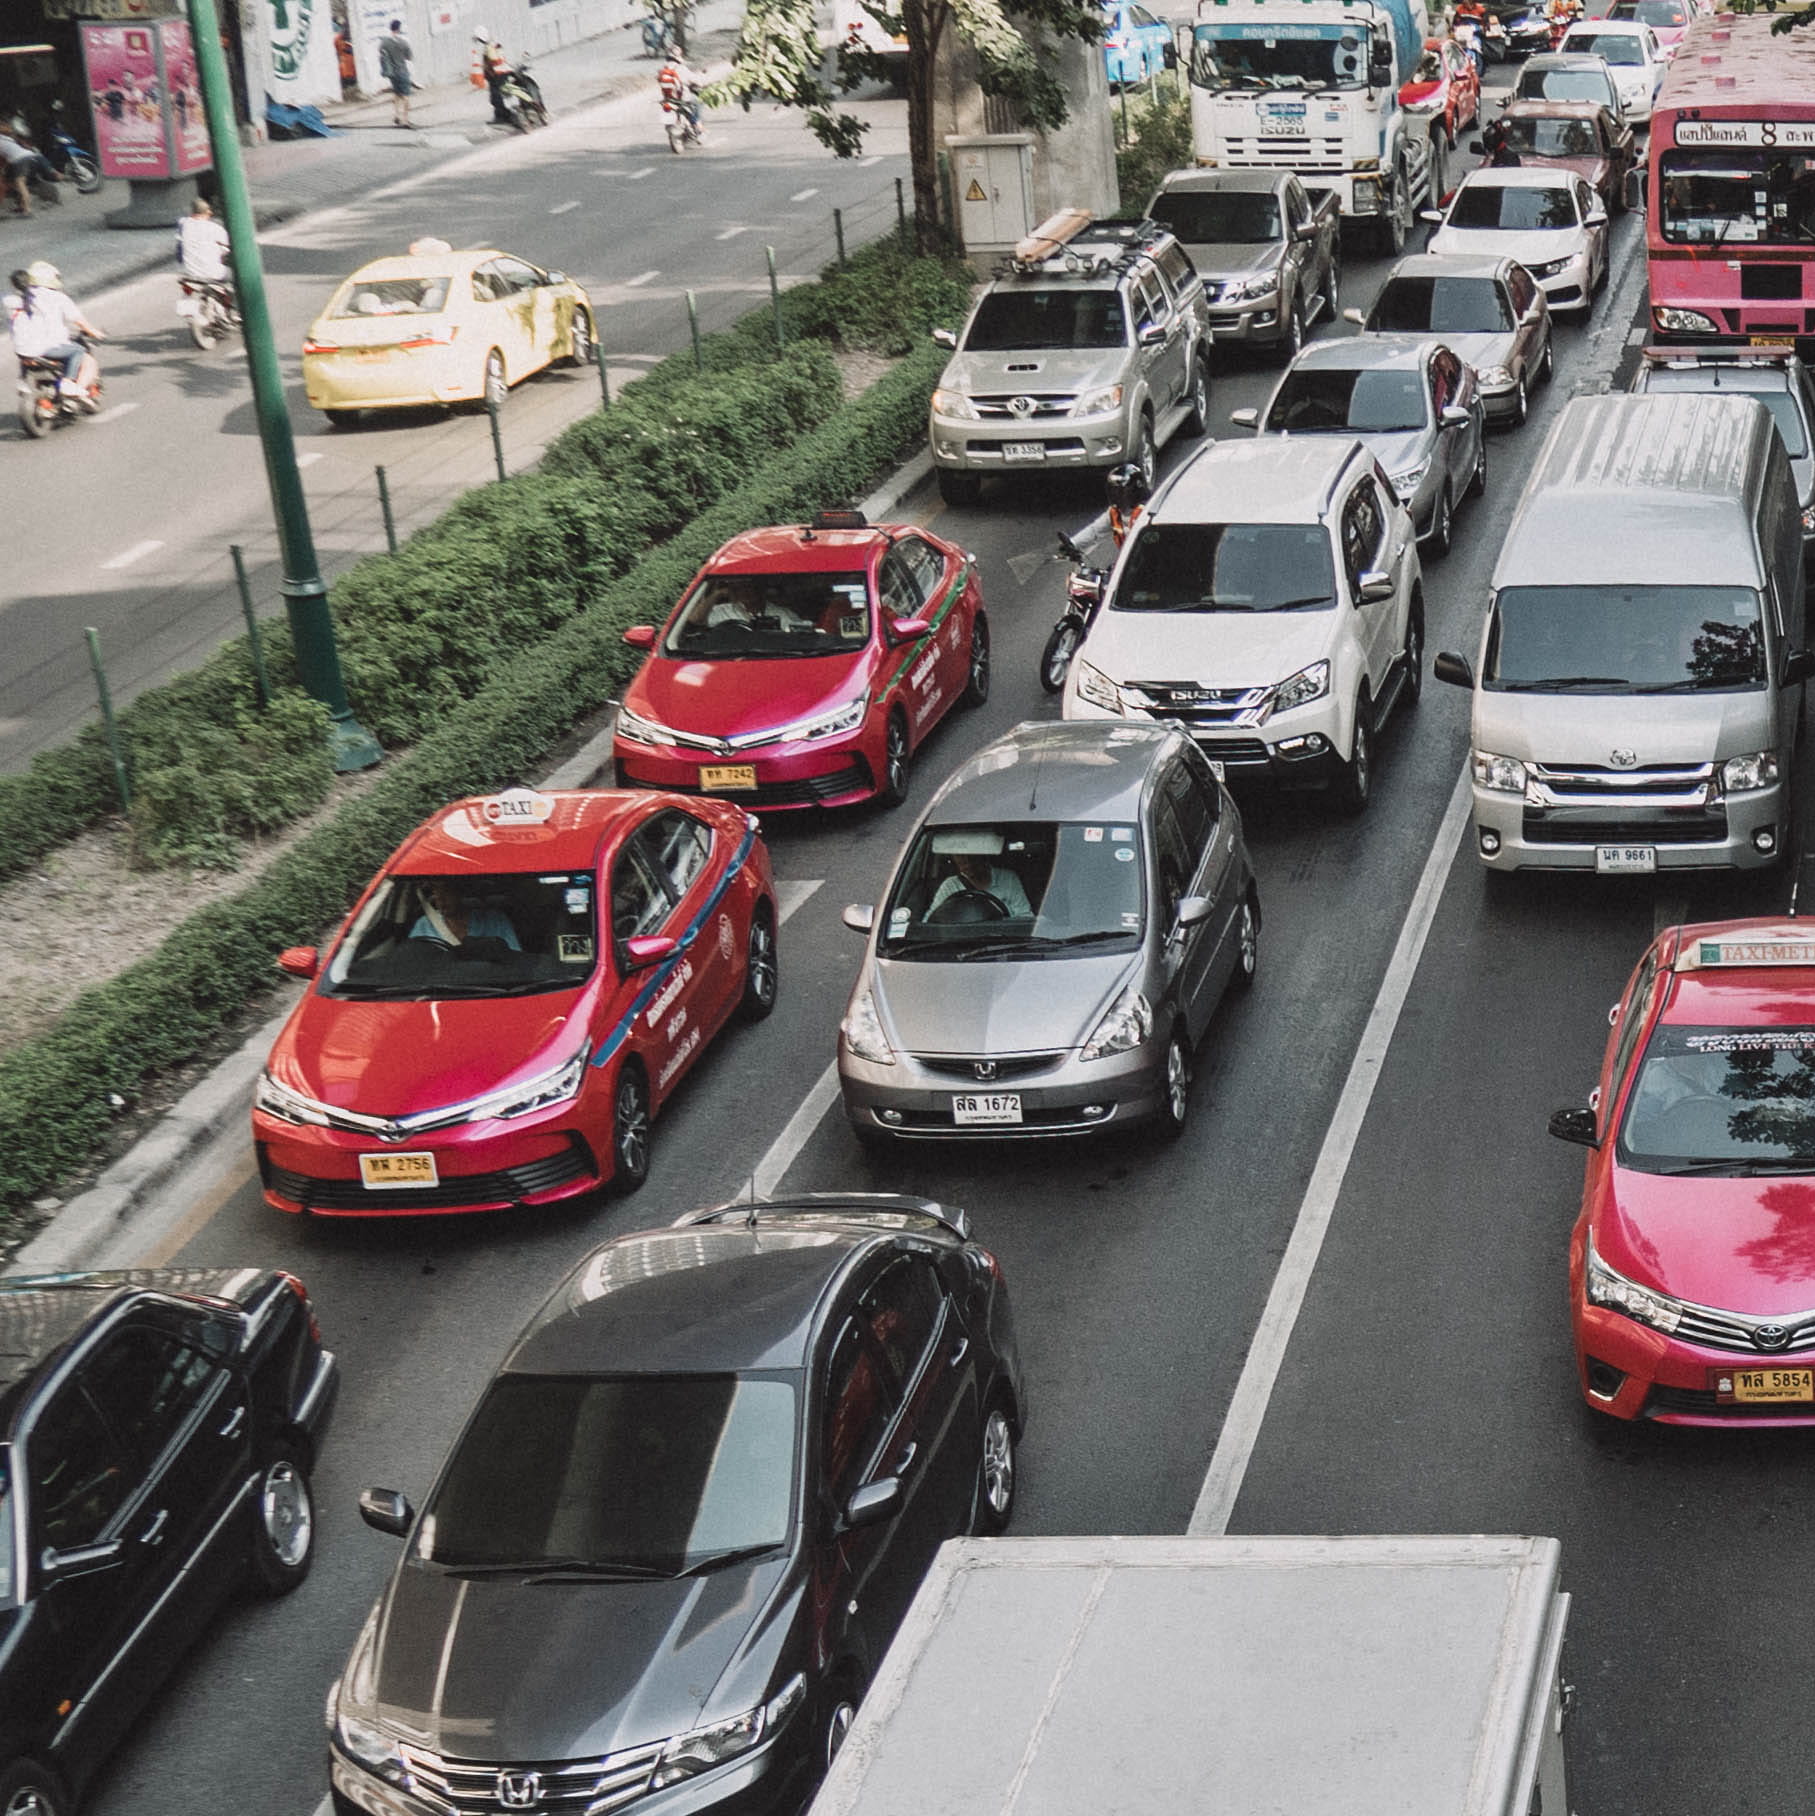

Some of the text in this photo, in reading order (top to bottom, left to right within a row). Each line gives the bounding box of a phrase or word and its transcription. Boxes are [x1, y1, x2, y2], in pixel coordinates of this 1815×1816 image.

[1259, 127, 1306, 136] ISUZU
[1760, 121, 1778, 146] 8
[1170, 690, 1222, 701] ISUZU
[502, 800, 533, 816] TAXI
[1625, 849, 1652, 861] 9661
[1700, 1044, 1737, 1053] LONG
[1739, 1043, 1771, 1051] LIVE
[1774, 1042, 1802, 1050] THE
[984, 1096, 1019, 1111] 1672
[1772, 1372, 1810, 1387] 5854
